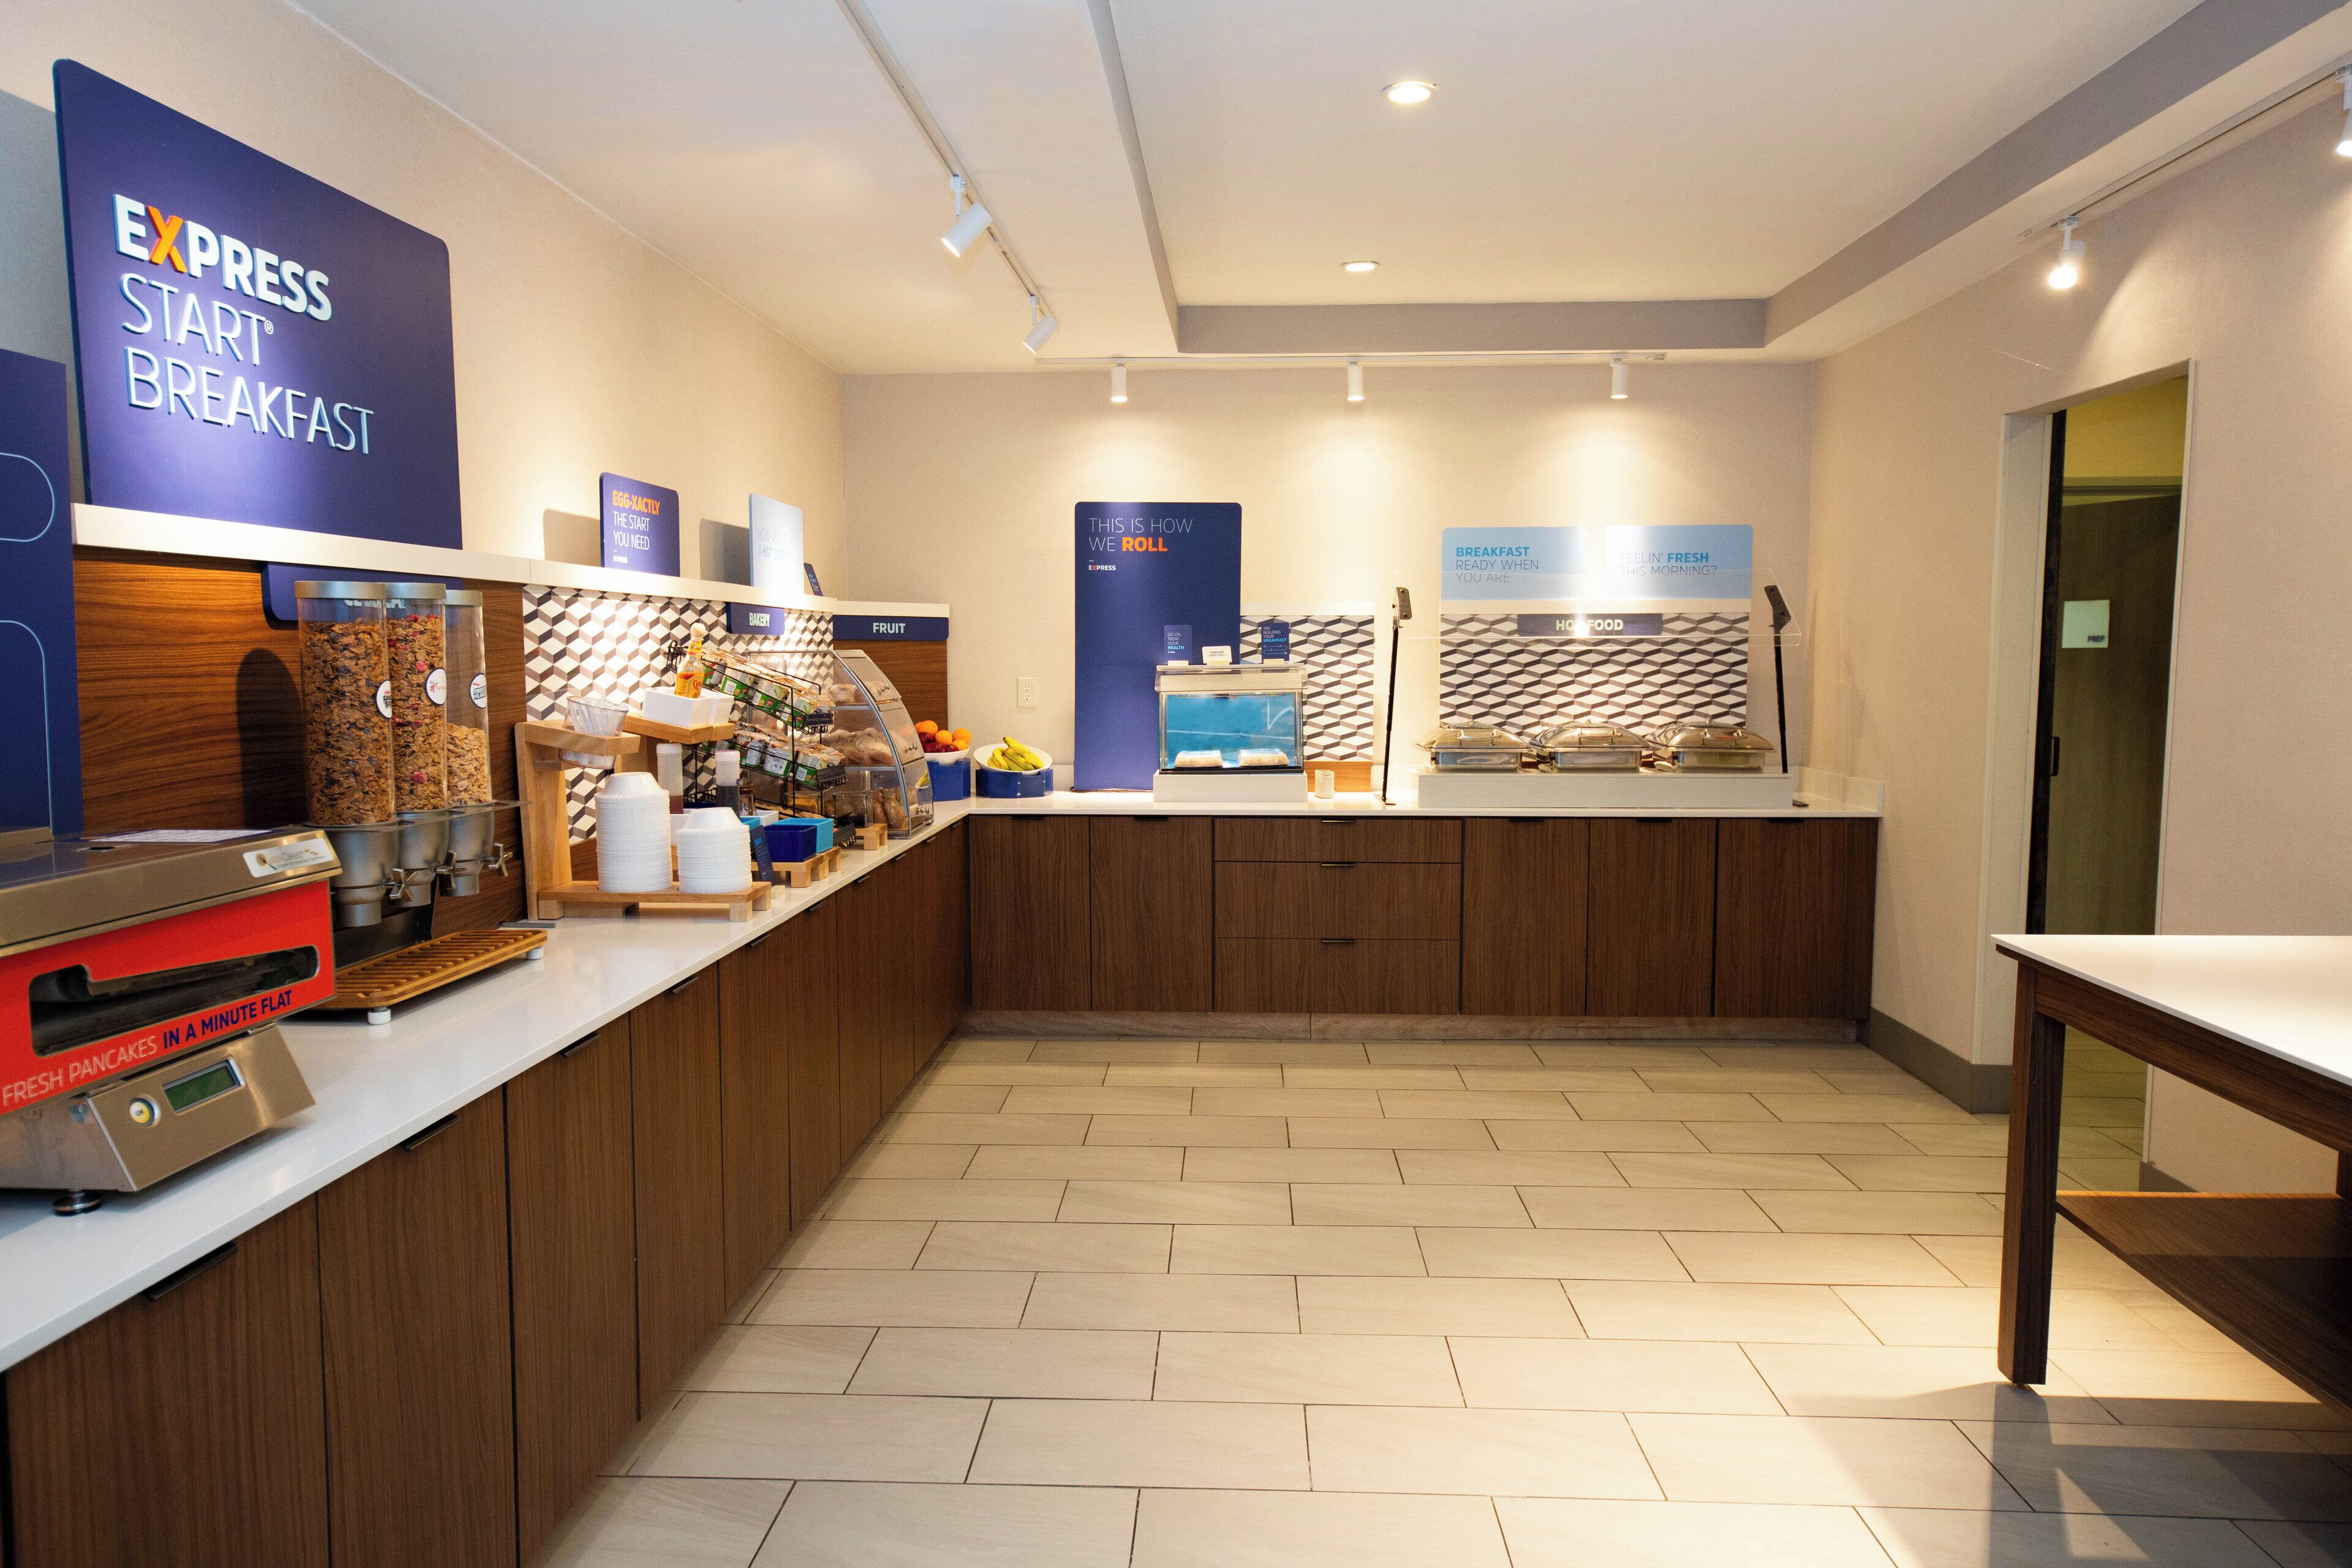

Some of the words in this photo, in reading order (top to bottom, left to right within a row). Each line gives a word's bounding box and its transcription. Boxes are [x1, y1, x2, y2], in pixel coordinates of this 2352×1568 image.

[113, 194, 332, 321] EXPRESS
[125, 347, 374, 454] BREAKFAST
[612, 489, 660, 515] EGG-XACTLY
[613, 511, 628, 528] THE
[629, 514, 650, 532] START
[1088, 518, 1125, 533] THIS
[1131, 518, 1144, 533] IS
[1151, 518, 1193, 533] HOW
[613, 530, 629, 548] YOU
[631, 534, 650, 550] NEED
[1088, 537, 1115, 551] WE
[1122, 537, 1168, 552] ROLL
[1456, 546, 1530, 557] BREAKFAST
[1667, 552, 1709, 563] FRESH
[1456, 559, 1496, 570] READY
[1501, 559, 1539, 570] WHEN
[1621, 566, 1646, 576] THIS
[1651, 565, 1717, 576] MORNING?
[1456, 573, 1481, 582] YOU
[1486, 573, 1510, 582] ARE
[748, 612, 770, 627] BAKERY
[1556, 619, 1578, 631] HO
[1587, 619, 1623, 631] FOOD
[873, 622, 906, 633] FRUIT
[2, 1068, 63, 1103] FRESH
[69, 1036, 157, 1082] PANCAKES
[162, 1028, 180, 1049] IN
[185, 1023, 197, 1041] A
[201, 1003, 257, 1036] MINUTE
[260, 990, 292, 1014] FLAT
